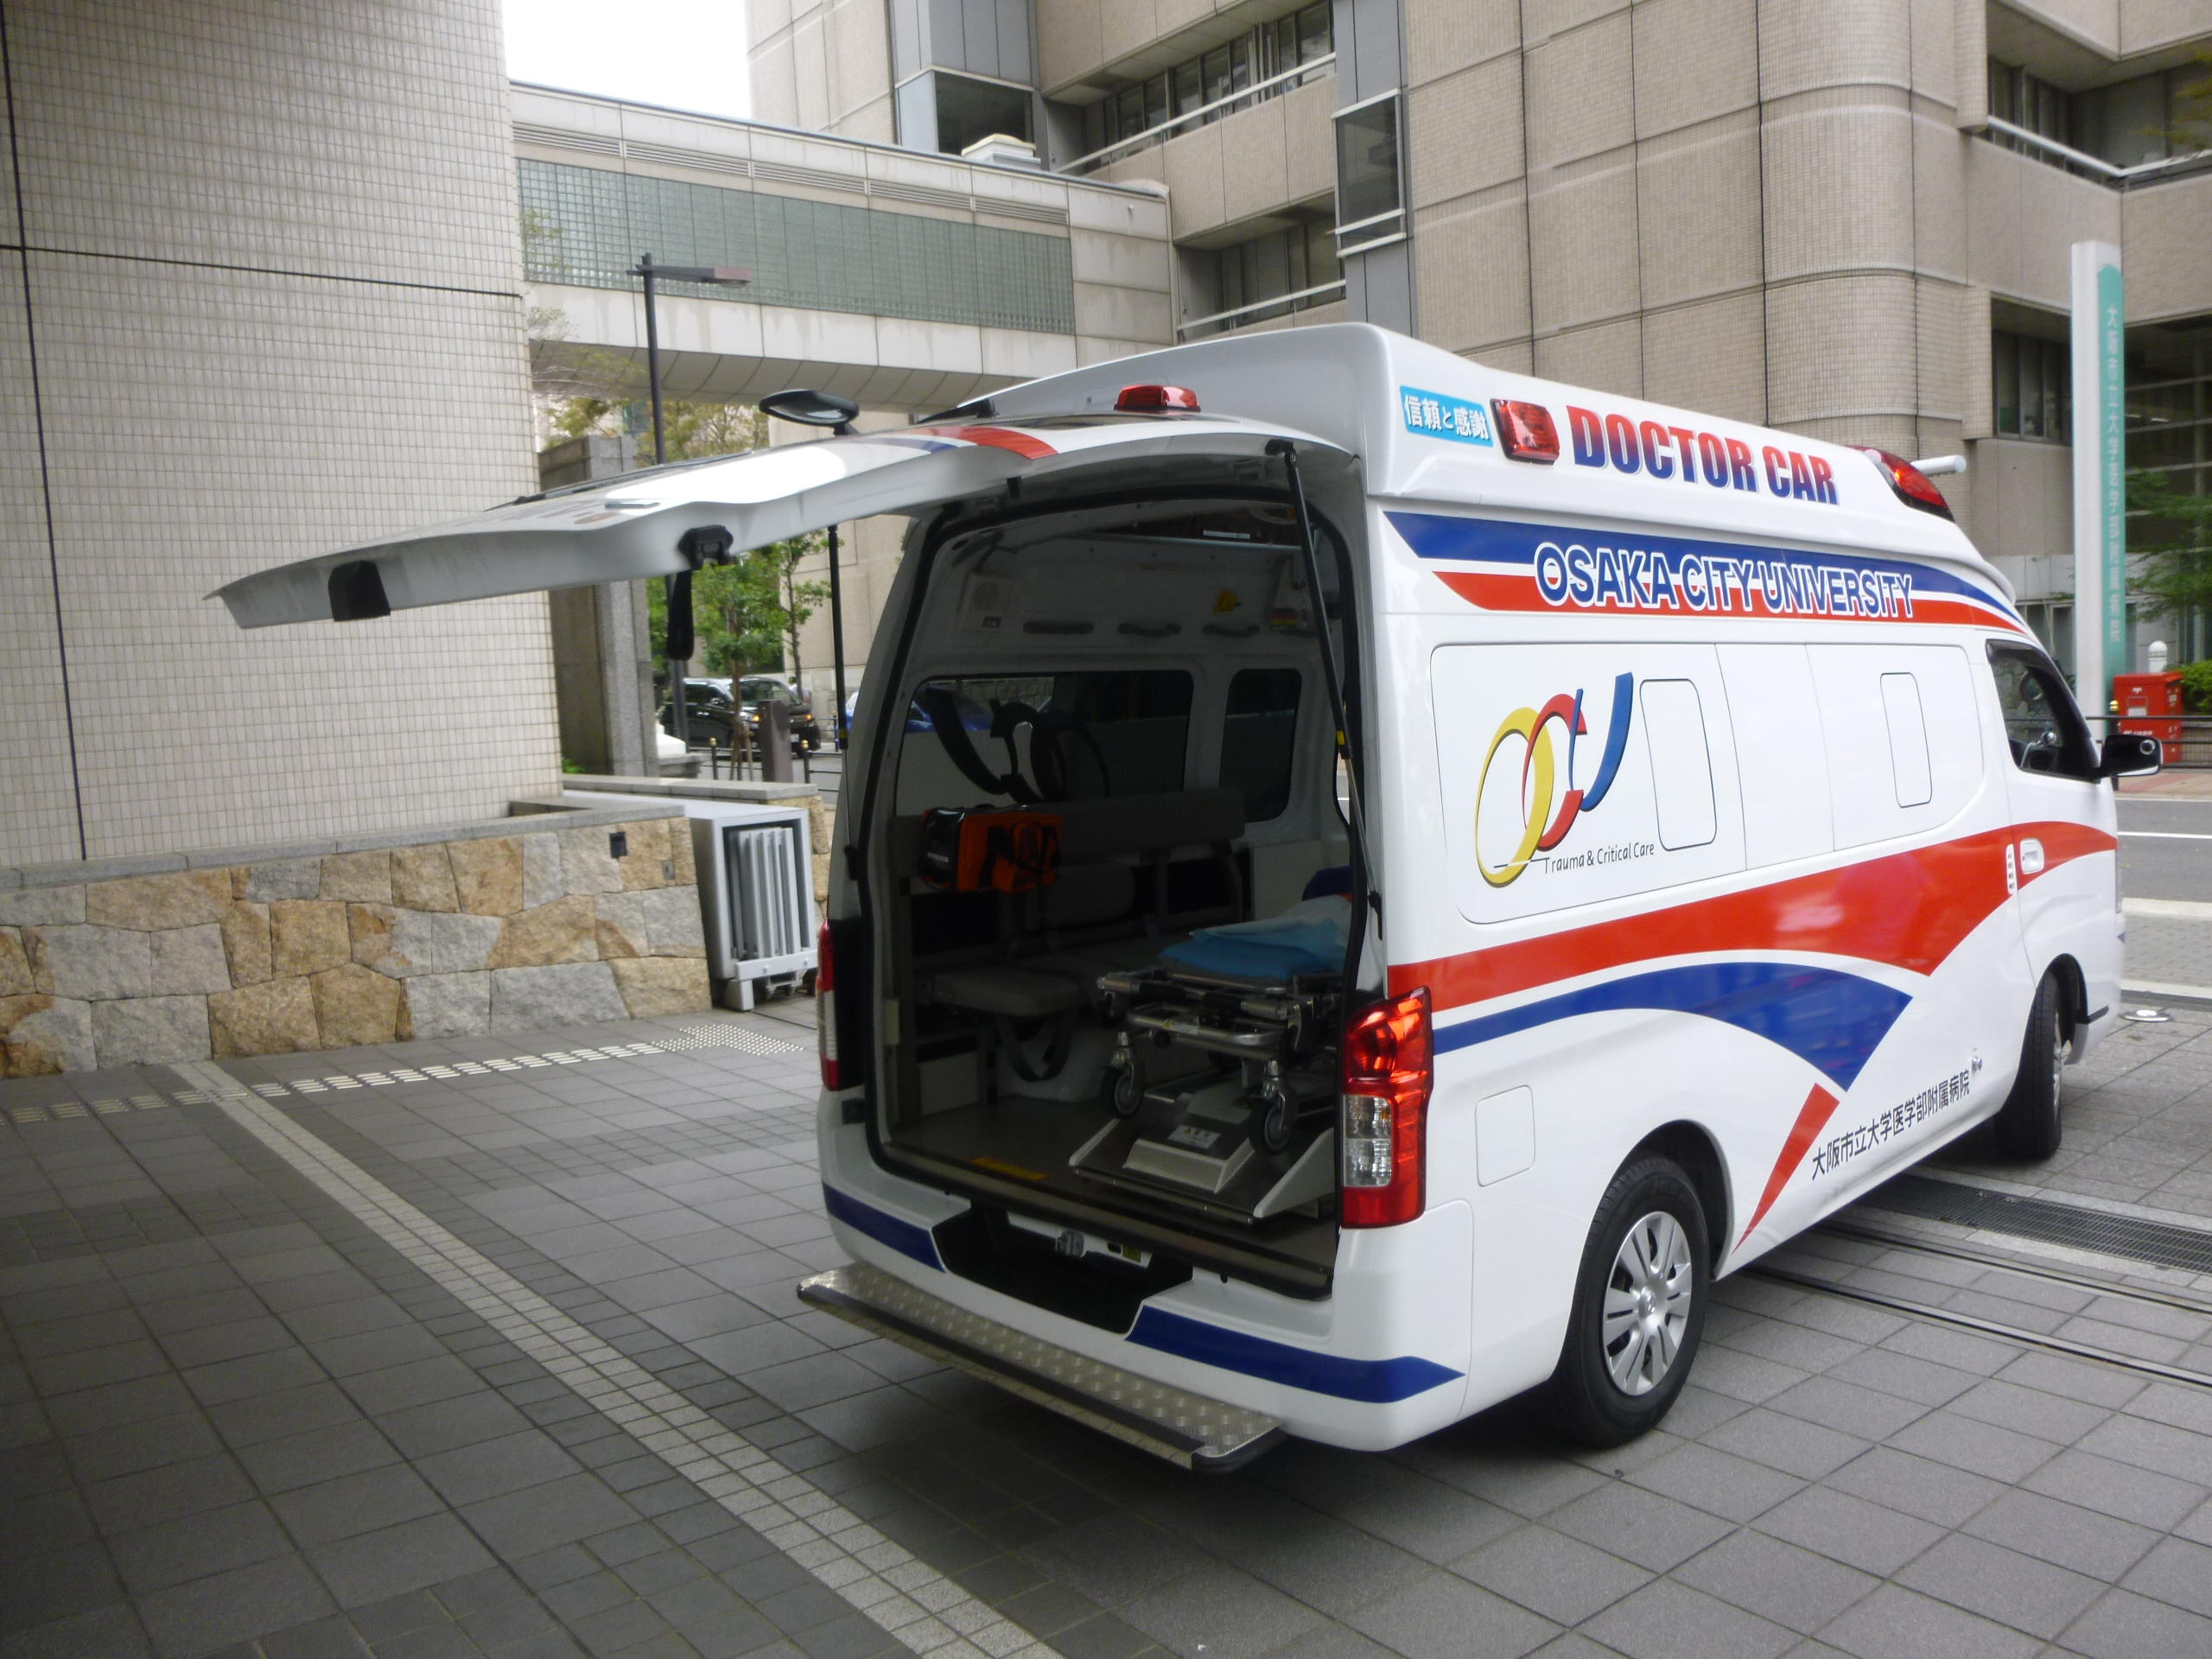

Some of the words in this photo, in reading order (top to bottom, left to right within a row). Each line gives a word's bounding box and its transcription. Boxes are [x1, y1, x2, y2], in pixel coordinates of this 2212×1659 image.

[1405, 394, 1490, 441] 信頼と感謝
[1566, 405, 1758, 493] DOCTOR
[1762, 445, 1840, 505] CAR
[1534, 542, 1678, 610] OSAKA
[1679, 552, 1755, 613] CITY
[1756, 560, 1914, 619] UNIVERSITY
[1530, 855, 1585, 874] Trauma
[1586, 850, 1595, 865] &
[1597, 843, 1631, 865] Critical
[1633, 842, 1655, 857] Care
[1812, 1070, 1970, 1181] 大阪市立大学医学部附属病院
